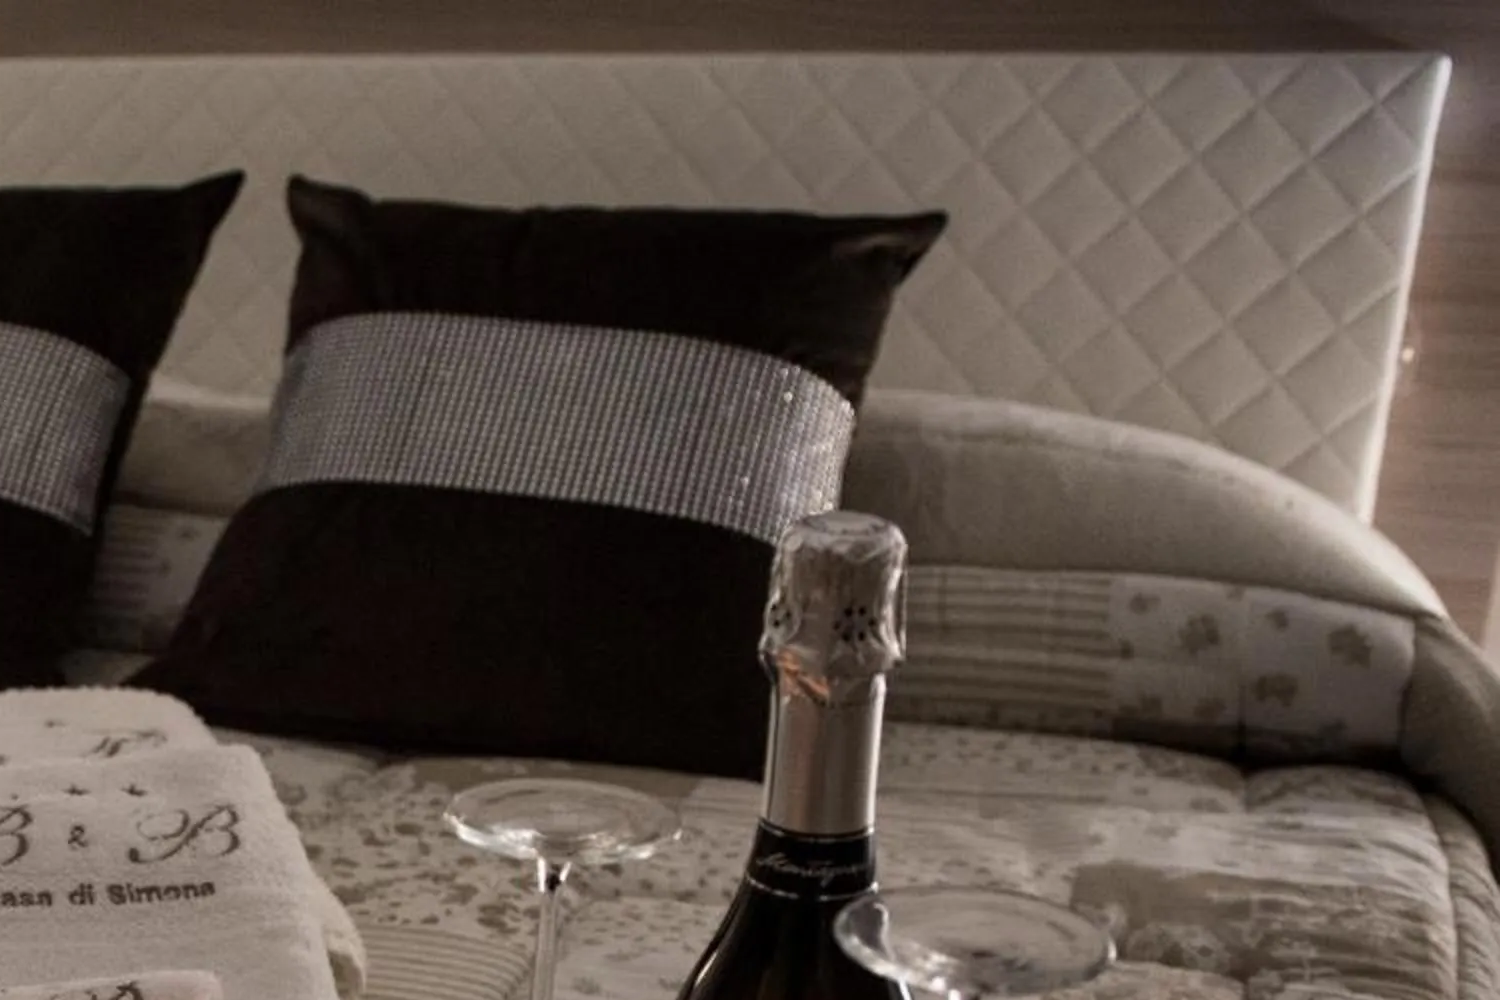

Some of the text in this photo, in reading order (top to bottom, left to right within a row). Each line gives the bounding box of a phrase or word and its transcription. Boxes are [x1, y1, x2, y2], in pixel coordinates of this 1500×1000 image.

[68, 825, 88, 848] &
[68, 883, 94, 906] di
[106, 881, 216, 905] Simona
